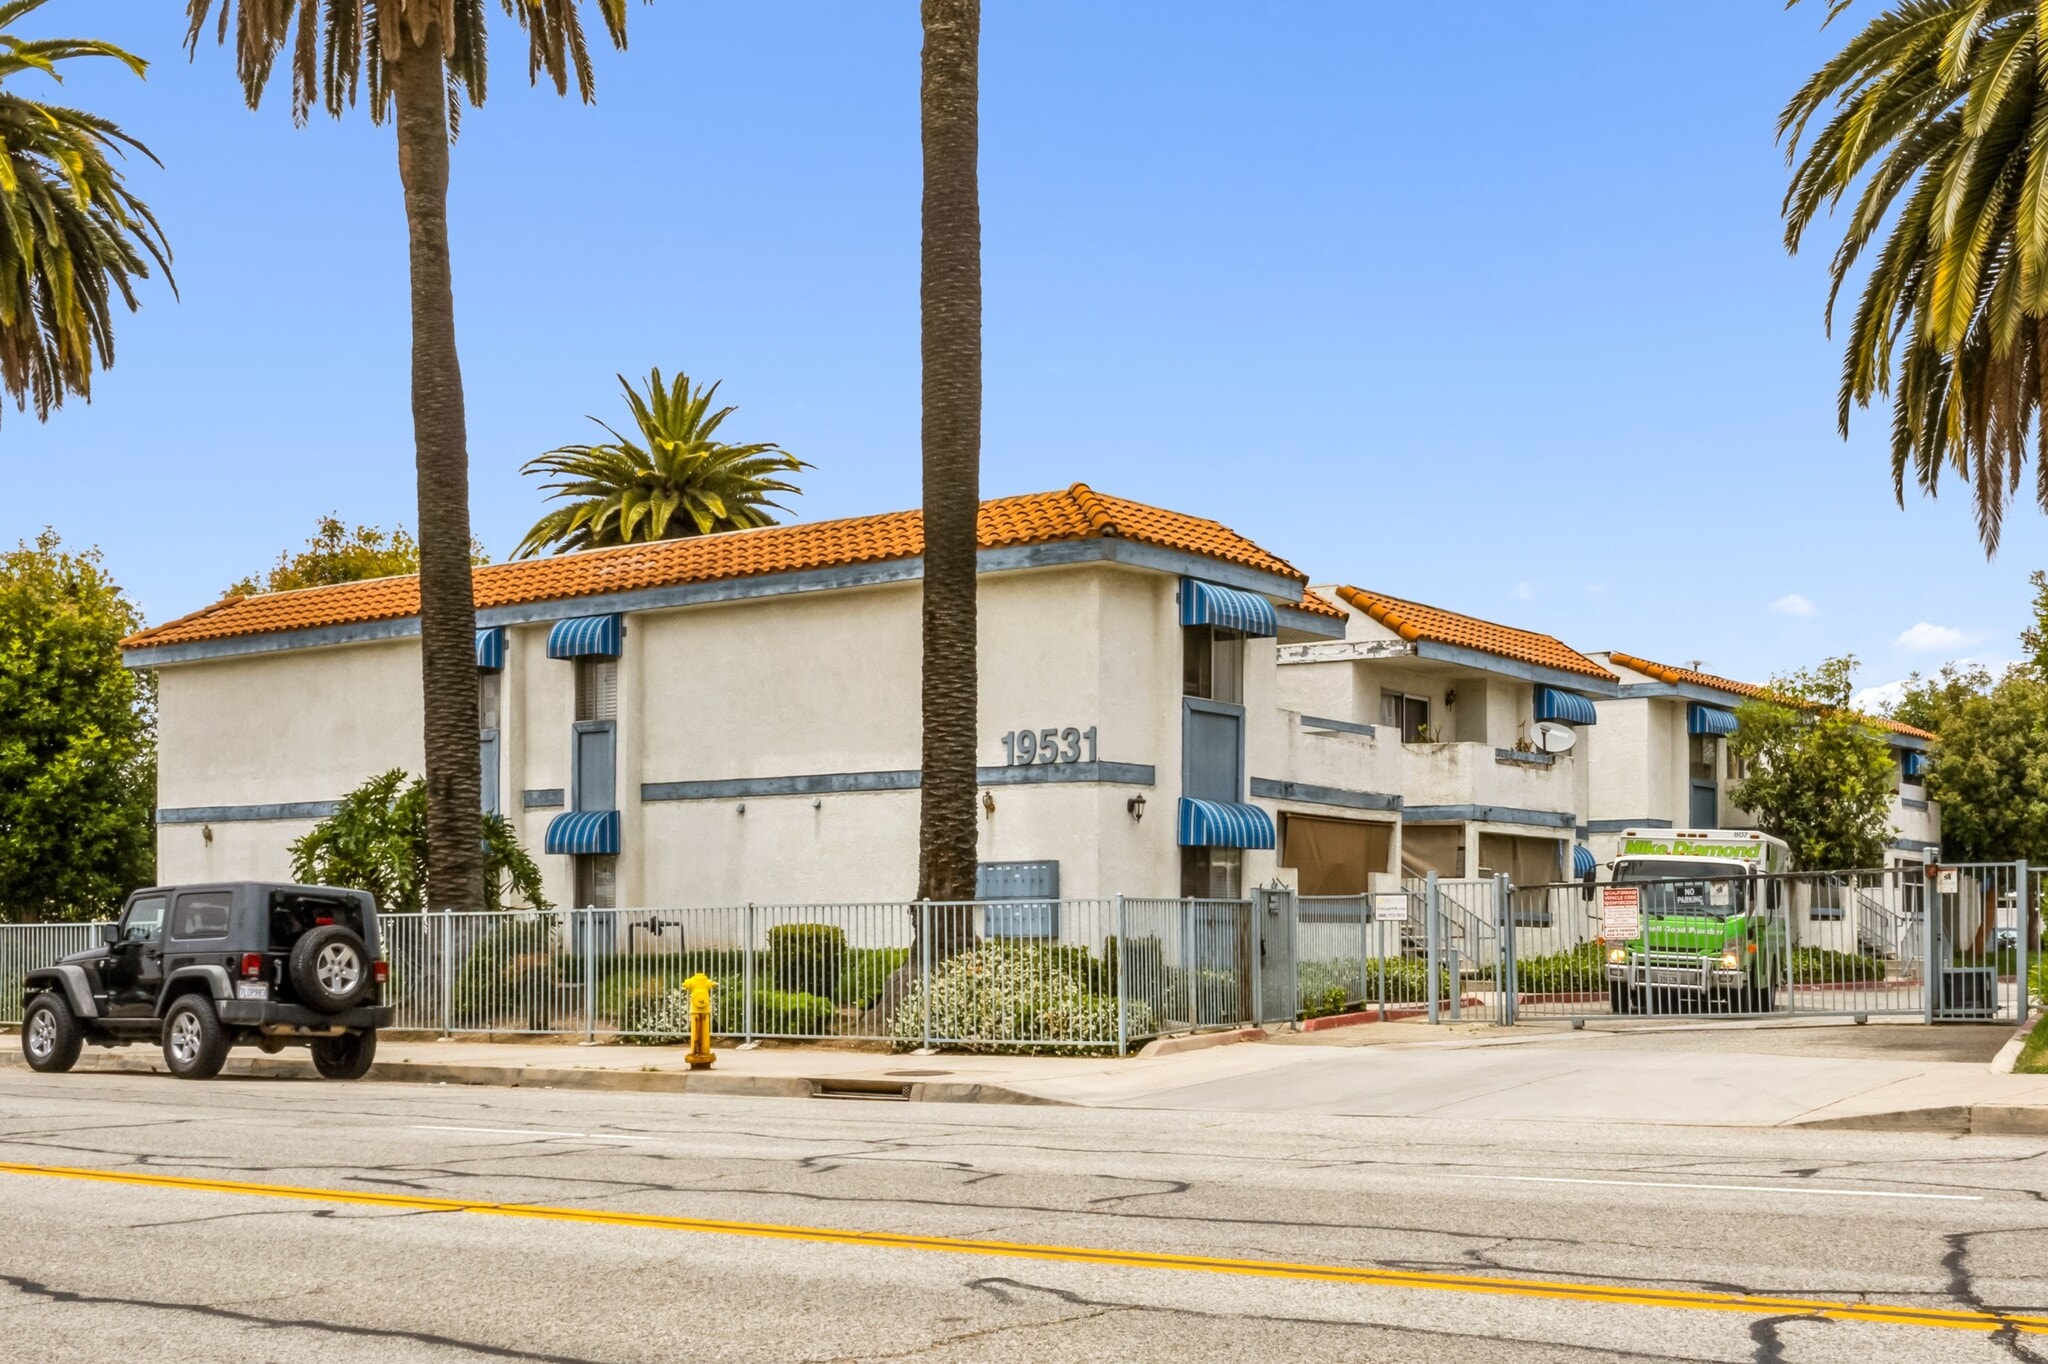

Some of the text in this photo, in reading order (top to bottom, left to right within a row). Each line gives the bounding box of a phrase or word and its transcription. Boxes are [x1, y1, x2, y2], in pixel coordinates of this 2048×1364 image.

[1001, 726, 1097, 766] 19531
[1624, 840, 1762, 858] Mike Diamond
[1684, 887, 1695, 896] NO
[1677, 895, 1704, 904] PARKING
